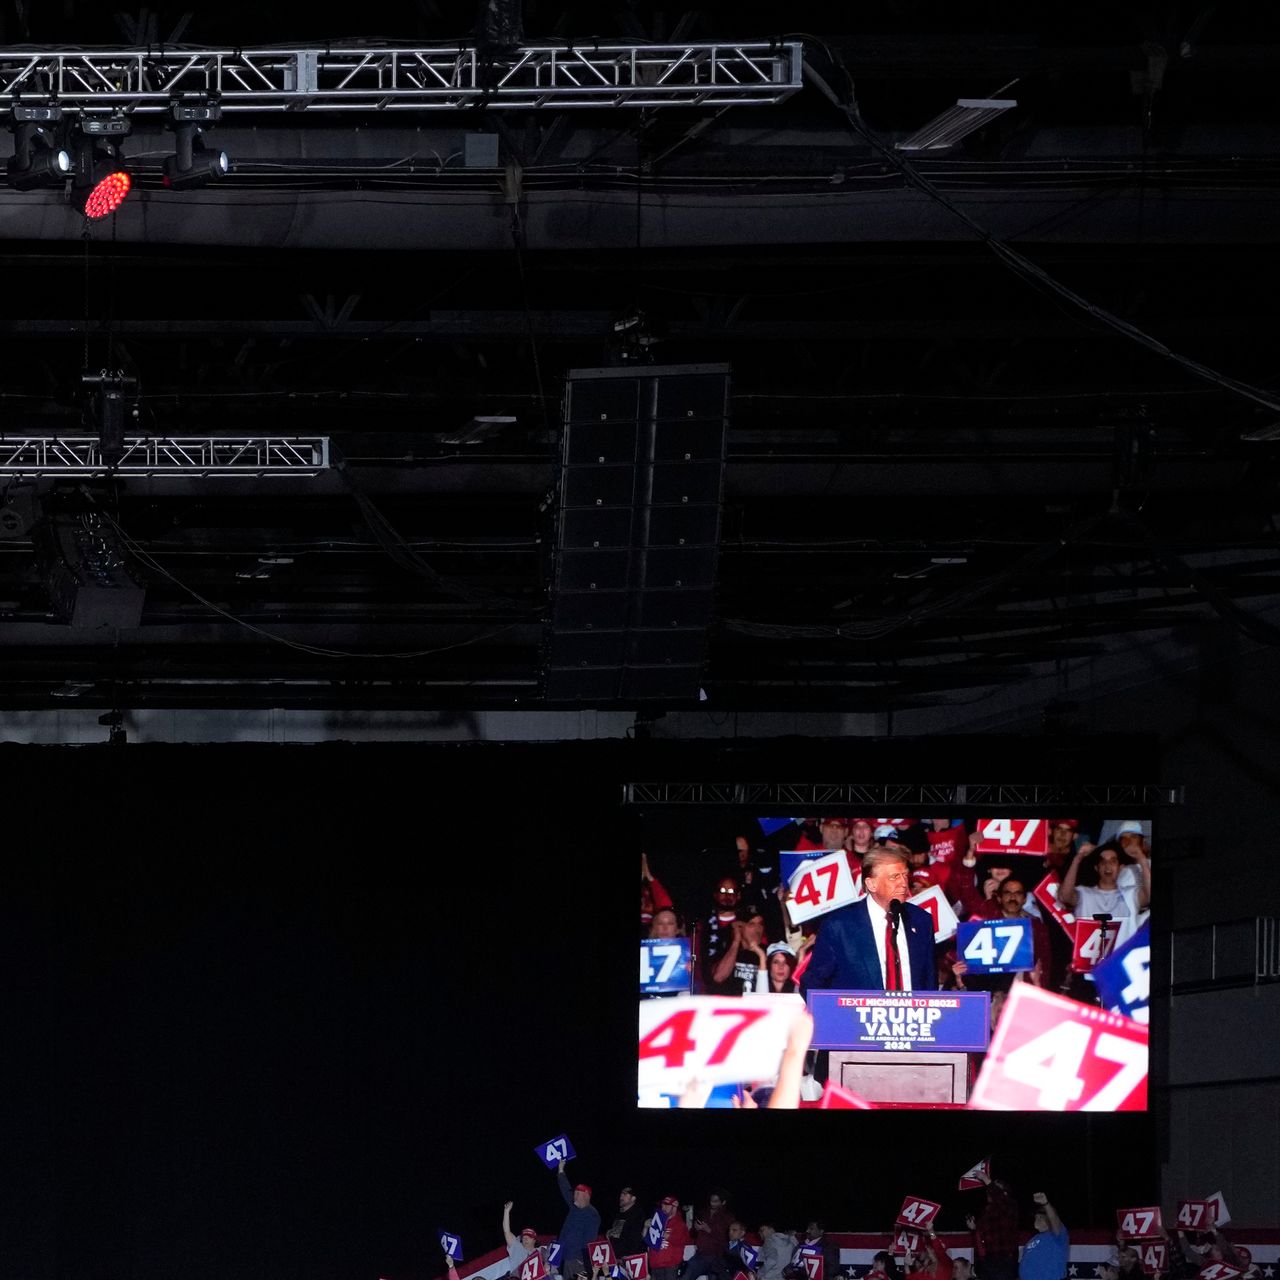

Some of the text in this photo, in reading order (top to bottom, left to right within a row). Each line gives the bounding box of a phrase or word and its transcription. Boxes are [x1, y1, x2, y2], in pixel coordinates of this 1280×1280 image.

[983, 819, 1040, 846] 47
[795, 863, 838, 900] 47
[964, 926, 1023, 964] 47
[840, 998, 864, 1006] TEXT
[866, 998, 912, 1006] MICHIGAN
[915, 998, 927, 1007] TO
[856, 1007, 941, 1024] TRUMP
[639, 1009, 768, 1067] 47
[865, 1023, 931, 1036] VANCE
[884, 1042, 911, 1050] 2024
[1005, 1020, 1148, 1111] 47
[545, 1138, 567, 1163] 47
[903, 1202, 934, 1223] 47
[1122, 1212, 1154, 1234] 47
